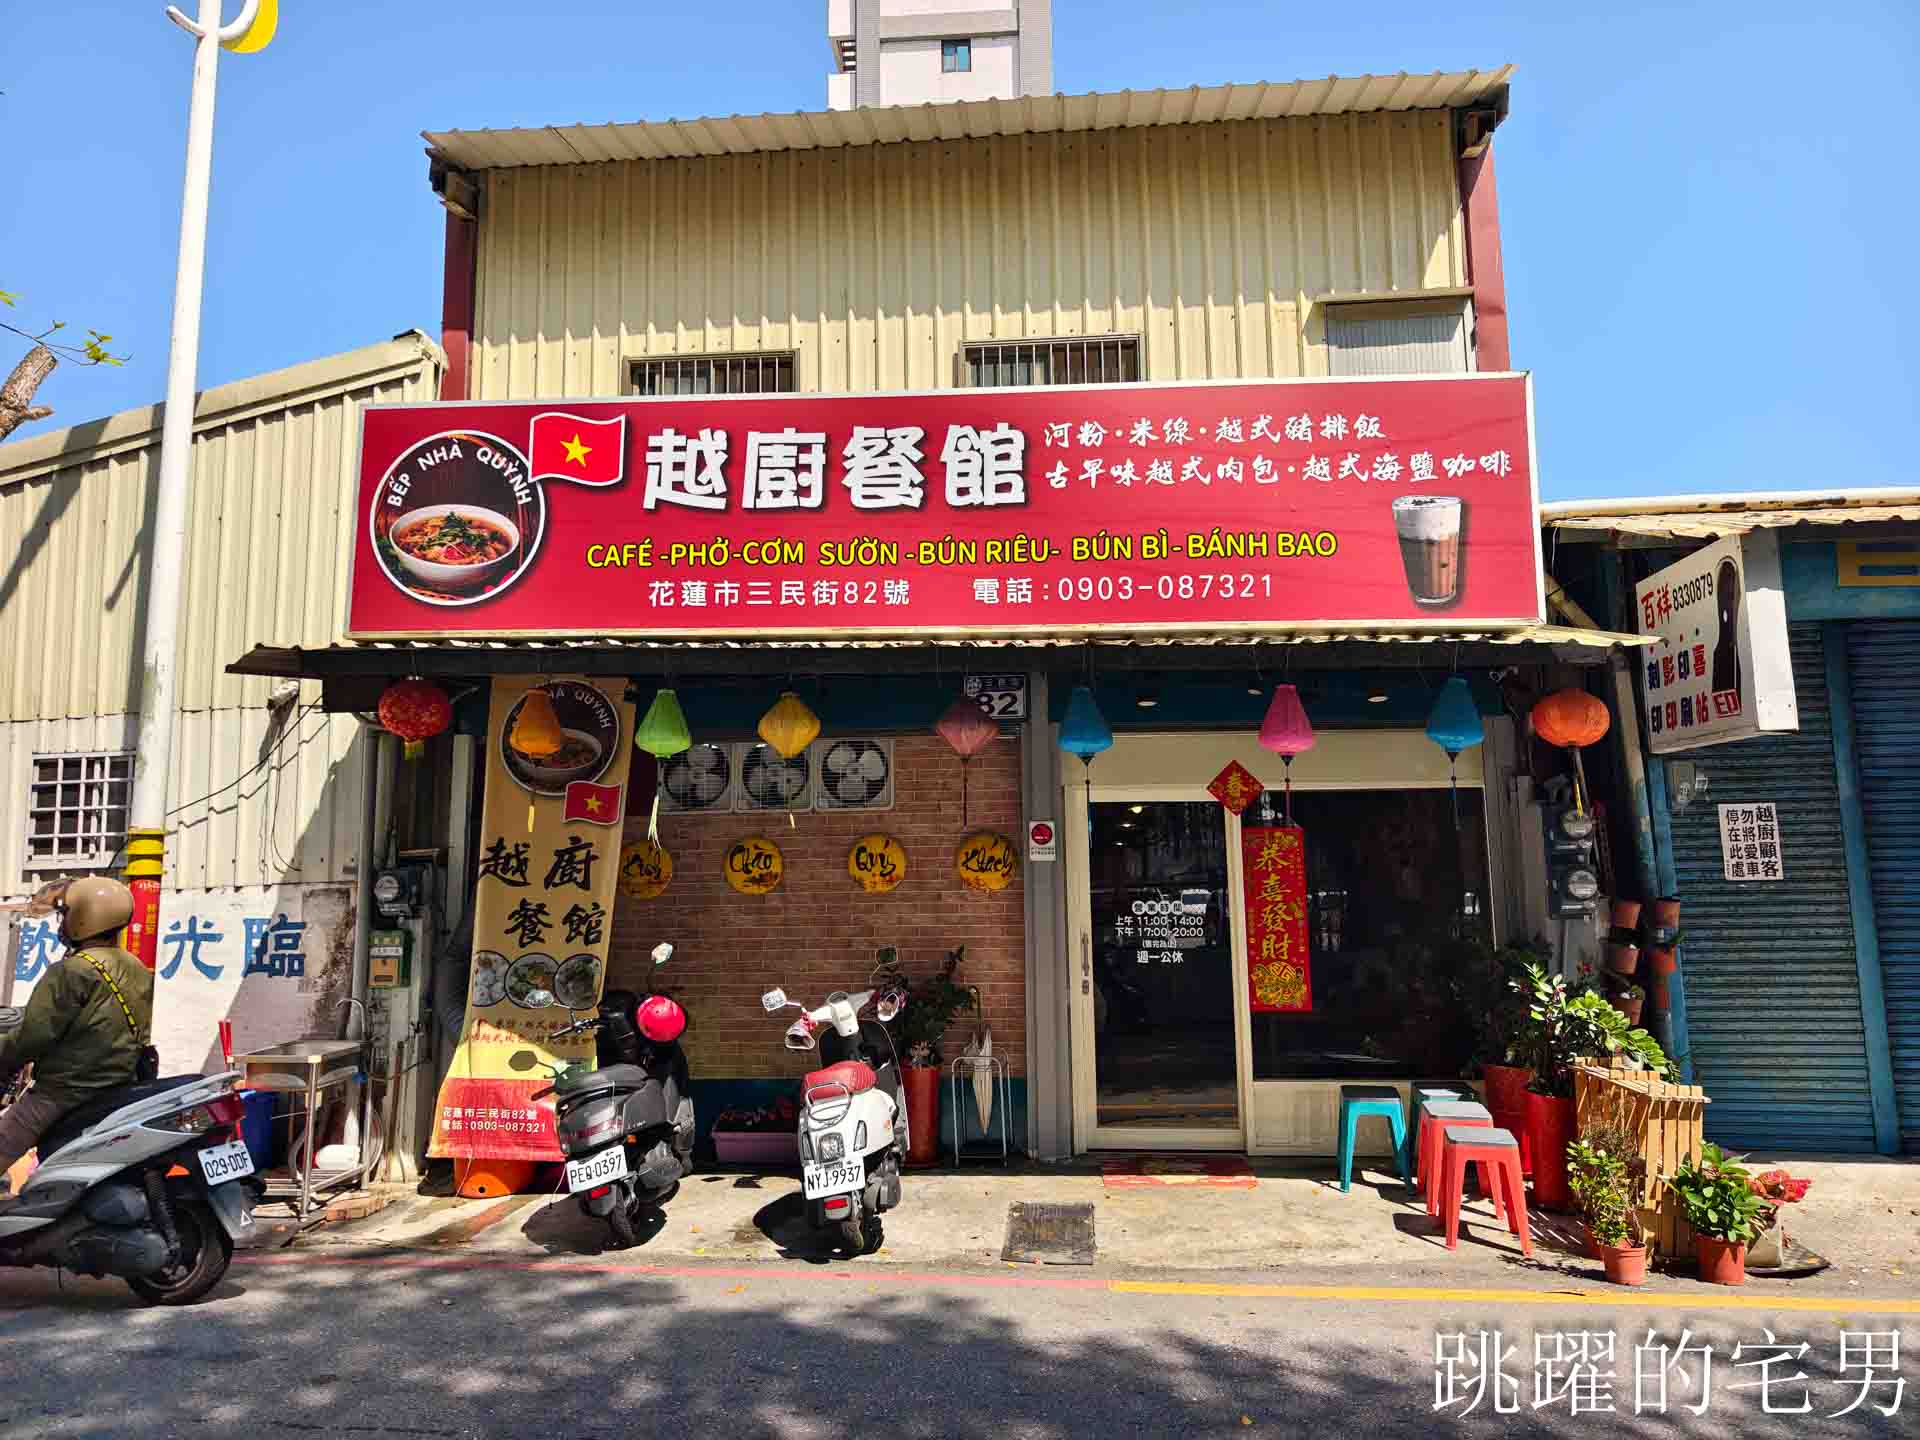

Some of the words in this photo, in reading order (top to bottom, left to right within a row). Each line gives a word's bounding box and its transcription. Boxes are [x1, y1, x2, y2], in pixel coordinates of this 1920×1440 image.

[387, 472, 412, 507] BẾP
[417, 439, 463, 471] NHÀ
[476, 447, 532, 505] QUỲNH
[642, 423, 1026, 511] 越廚餐館
[586, 538, 652, 568] CAFÉ
[819, 537, 898, 566] SƯỜN
[1072, 531, 1132, 561] BÚN
[1276, 531, 1338, 559] BAO
[648, 579, 910, 608] 花蓮市三民街82號
[1640, 583, 1672, 631] 百祥
[1672, 572, 1713, 611] 8330879
[977, 693, 1018, 715] 82
[480, 836, 599, 891] 越廚
[1726, 809, 1745, 877] 停在此處
[1741, 808, 1761, 877] 勿將愛車
[1755, 805, 1779, 878] 越廚顧客
[504, 897, 606, 949] 餐館
[1115, 916, 1134, 926] 上午
[1254, 833, 1294, 961] 恭喜發財
[1115, 927, 1134, 937] 下午
[1136, 950, 1184, 964] 週一公休
